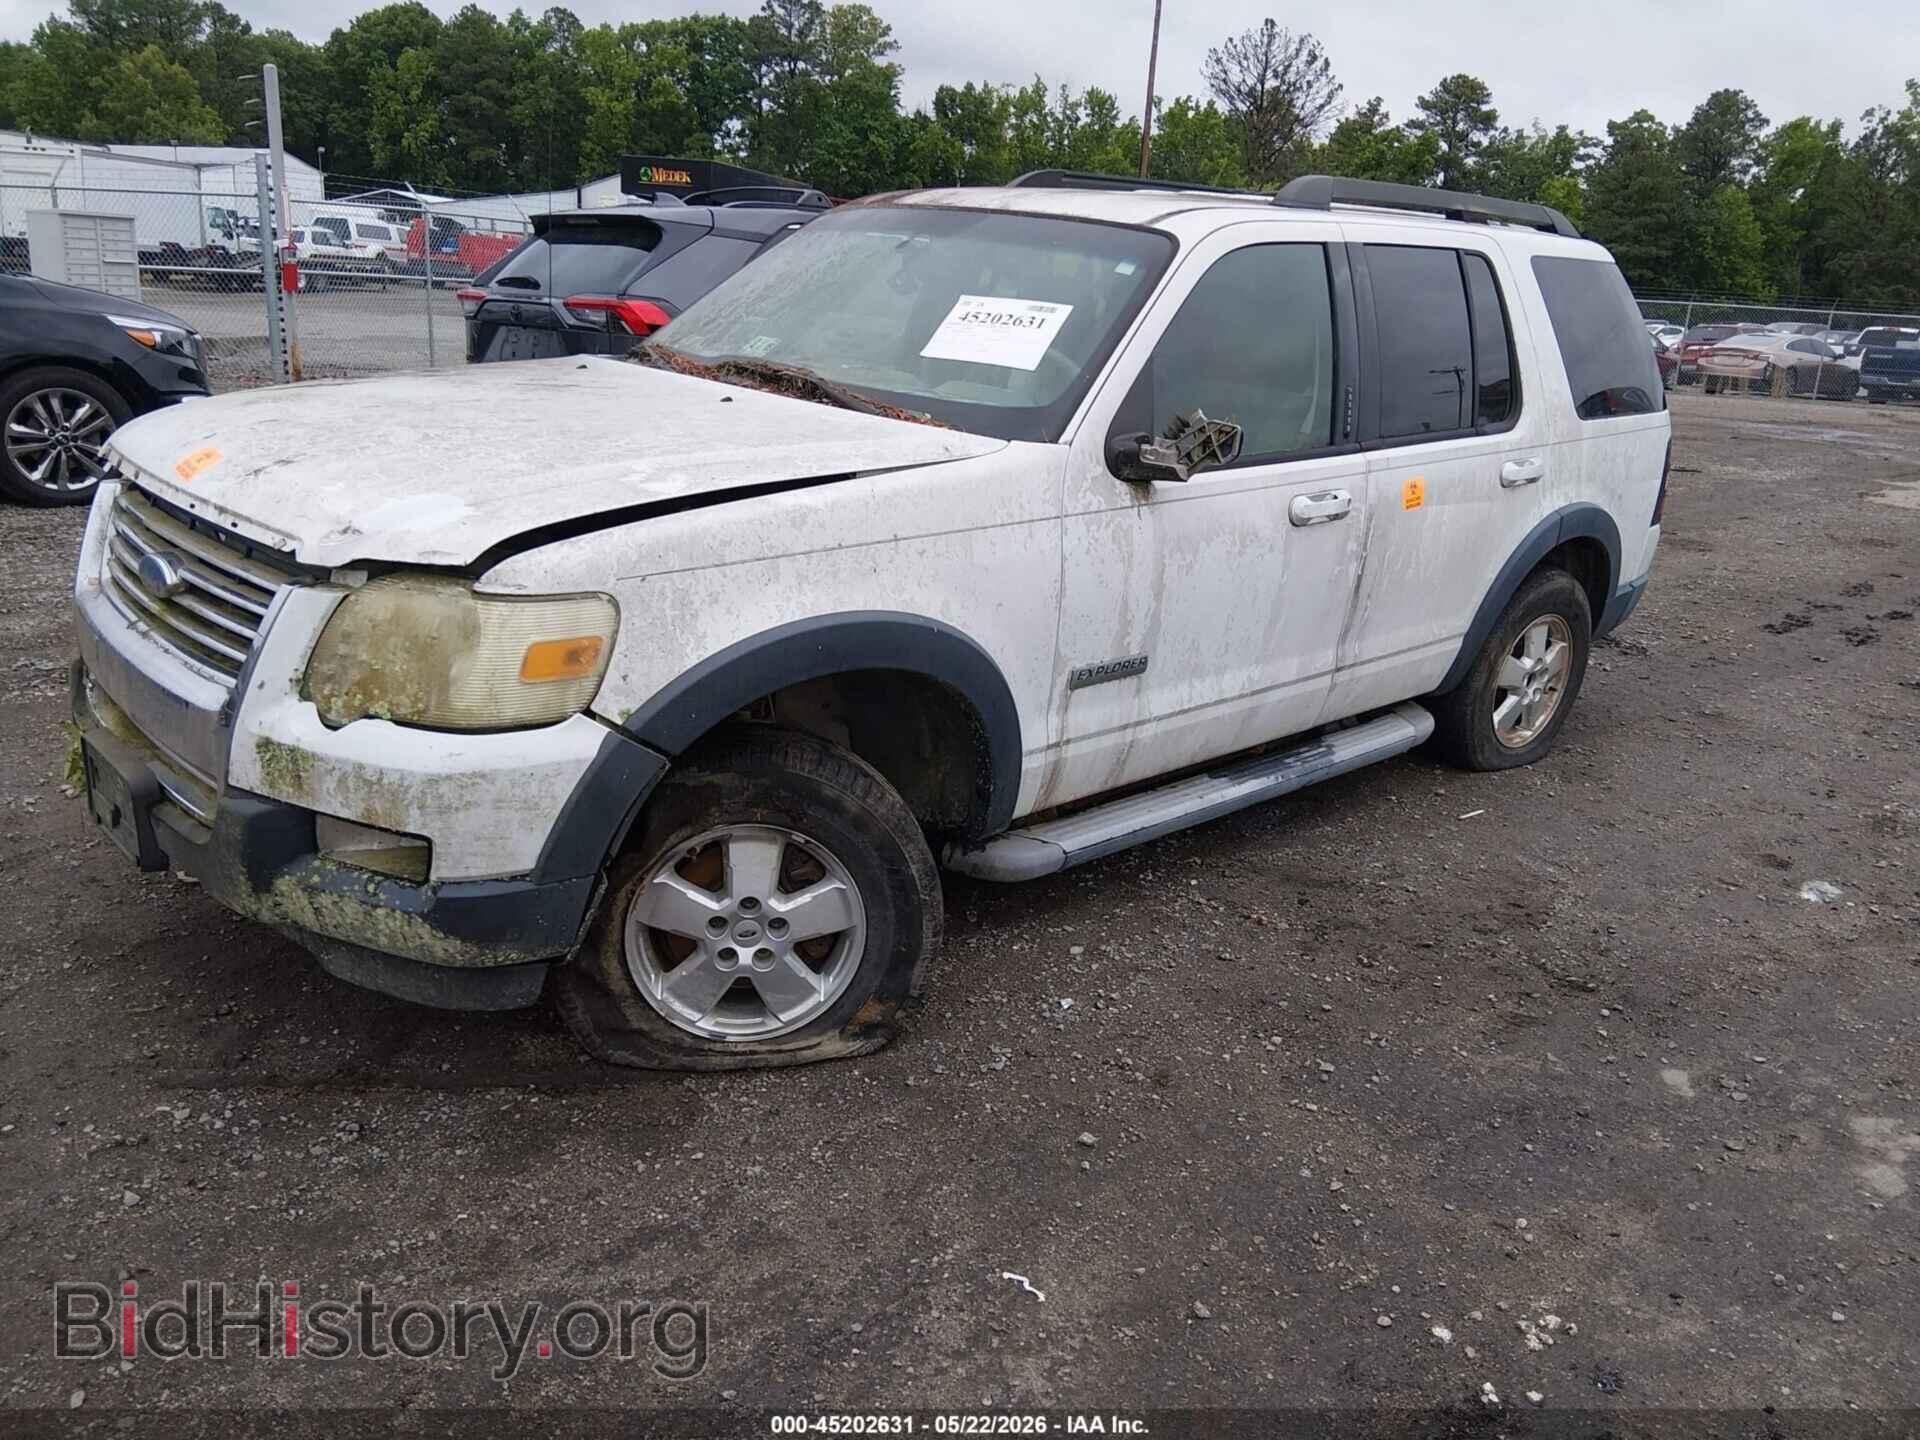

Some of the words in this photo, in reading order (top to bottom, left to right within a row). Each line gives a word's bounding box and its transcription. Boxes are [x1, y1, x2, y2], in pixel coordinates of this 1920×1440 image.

[651, 166, 691, 183] MEDEK
[958, 311, 1047, 329] 45202631
[1077, 656, 1148, 681] EXPLORER
